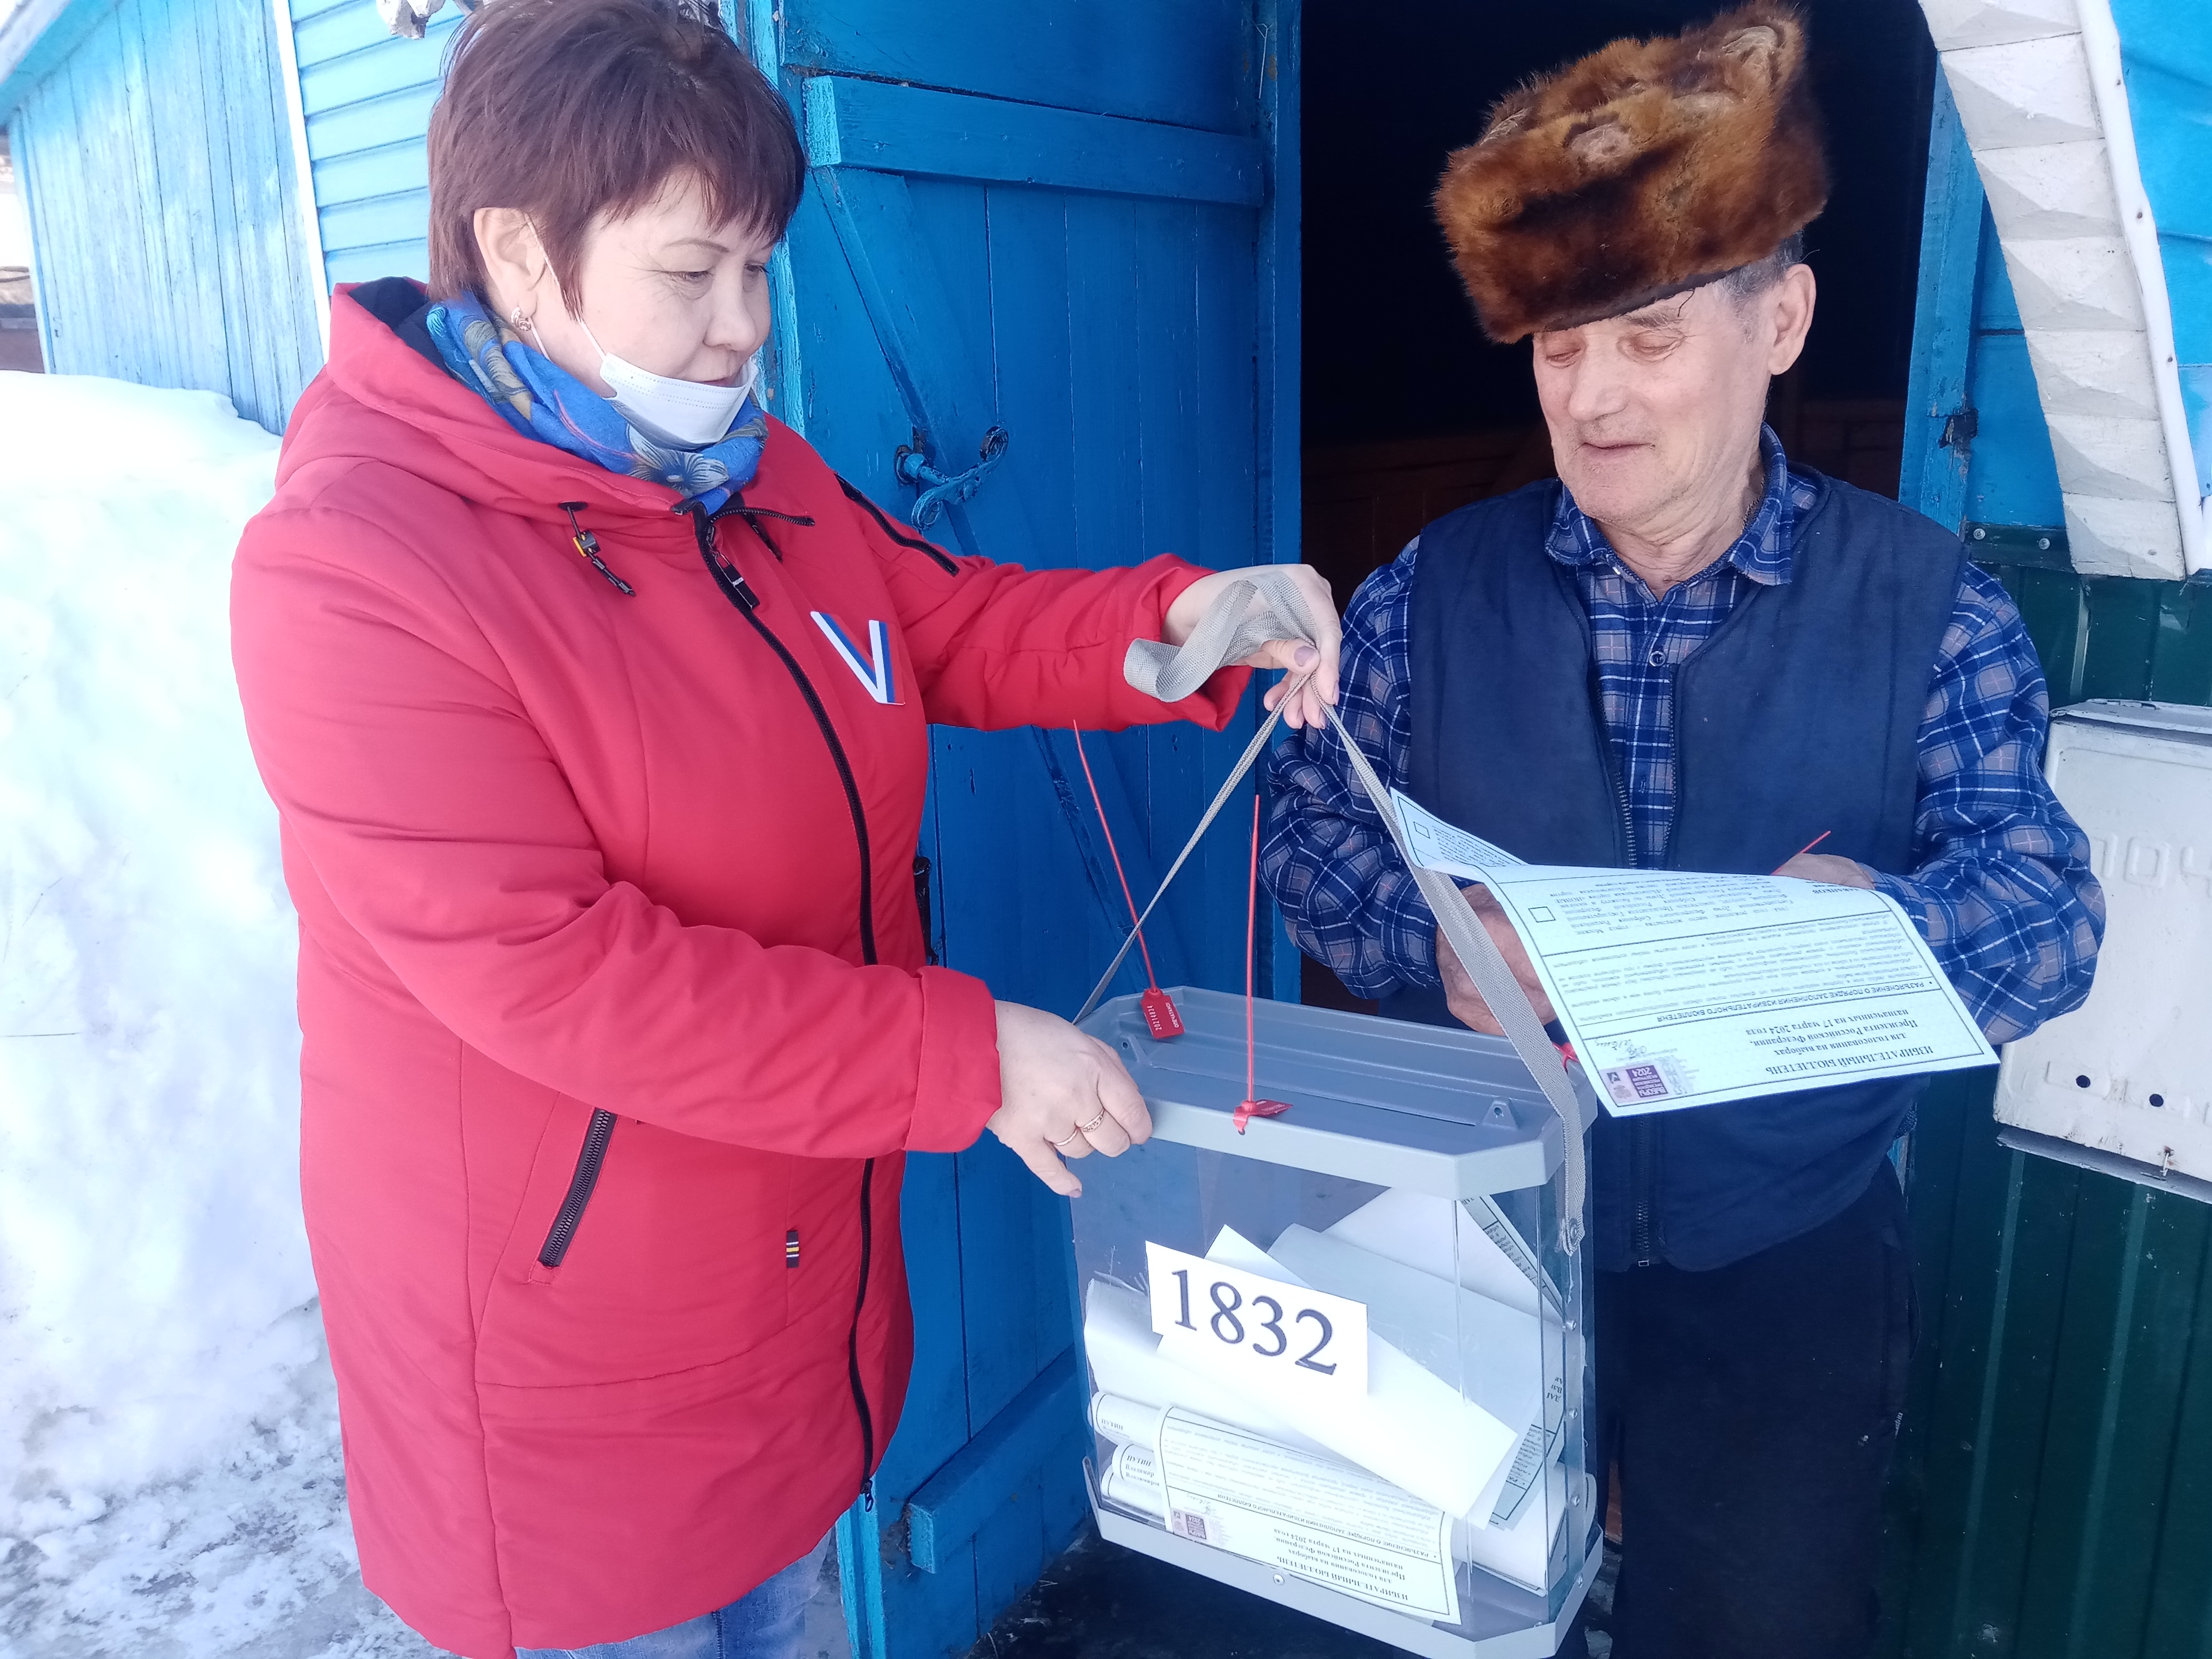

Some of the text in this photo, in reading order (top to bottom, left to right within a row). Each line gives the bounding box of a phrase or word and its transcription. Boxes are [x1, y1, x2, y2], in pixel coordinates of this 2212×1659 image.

[1871, 982, 1924, 992] РАЗЪЯСНЕНИЕ
[1778, 993, 1828, 1004] ЗАПОЛНЕНИЯ
[1829, 989, 1863, 998] ПОРЯДКЕ
[1707, 1000, 1777, 1013] ИЗБИРАТЕЛЬНОГО
[1147, 1006, 1162, 1031] 20214834
[1165, 1002, 1179, 1028] ОПЕЧАТАНО!
[1657, 1010, 1705, 1021] БЮЛЛЕТЕНЯ
[1847, 1009, 1908, 1021] назначенных
[1750, 1019, 1917, 1045] Президента Российской Федерации,
[1769, 1025, 1790, 1034] 2024
[1829, 1035, 1889, 1048] голосования
[1773, 1046, 1814, 1054] выборах
[1765, 1046, 1933, 1074] ИЗБИРАТЕЛЬНЫЙ БЮЛЛЕТЕНЬ
[1631, 1067, 1652, 1077] 2024
[1171, 1269, 1337, 1376] 1832
[1218, 1494, 1251, 1506] БЮЛЛЕТЕНЯ
[1252, 1504, 1304, 1522] ИЗБИРАТЕЛЬНОГО
[1306, 1520, 1344, 1534] ЗАПОЛНЕНИЯ
[1291, 1534, 1306, 1543] 2024
[1348, 1532, 1375, 1542] ПОРЯДКЕ
[1309, 1539, 1329, 1548] марта
[1384, 1541, 1428, 1557] РАЗЪЯСНЕНИЕ
[1288, 1549, 1318, 1561] выборах
[1353, 1552, 1402, 1569] назначенных
[1331, 1562, 1376, 1579] голосования
[1277, 1556, 1407, 1600] ИЗБИРАТЕЛЬНЫЙ БЮЛЛЕТЕНЬ
